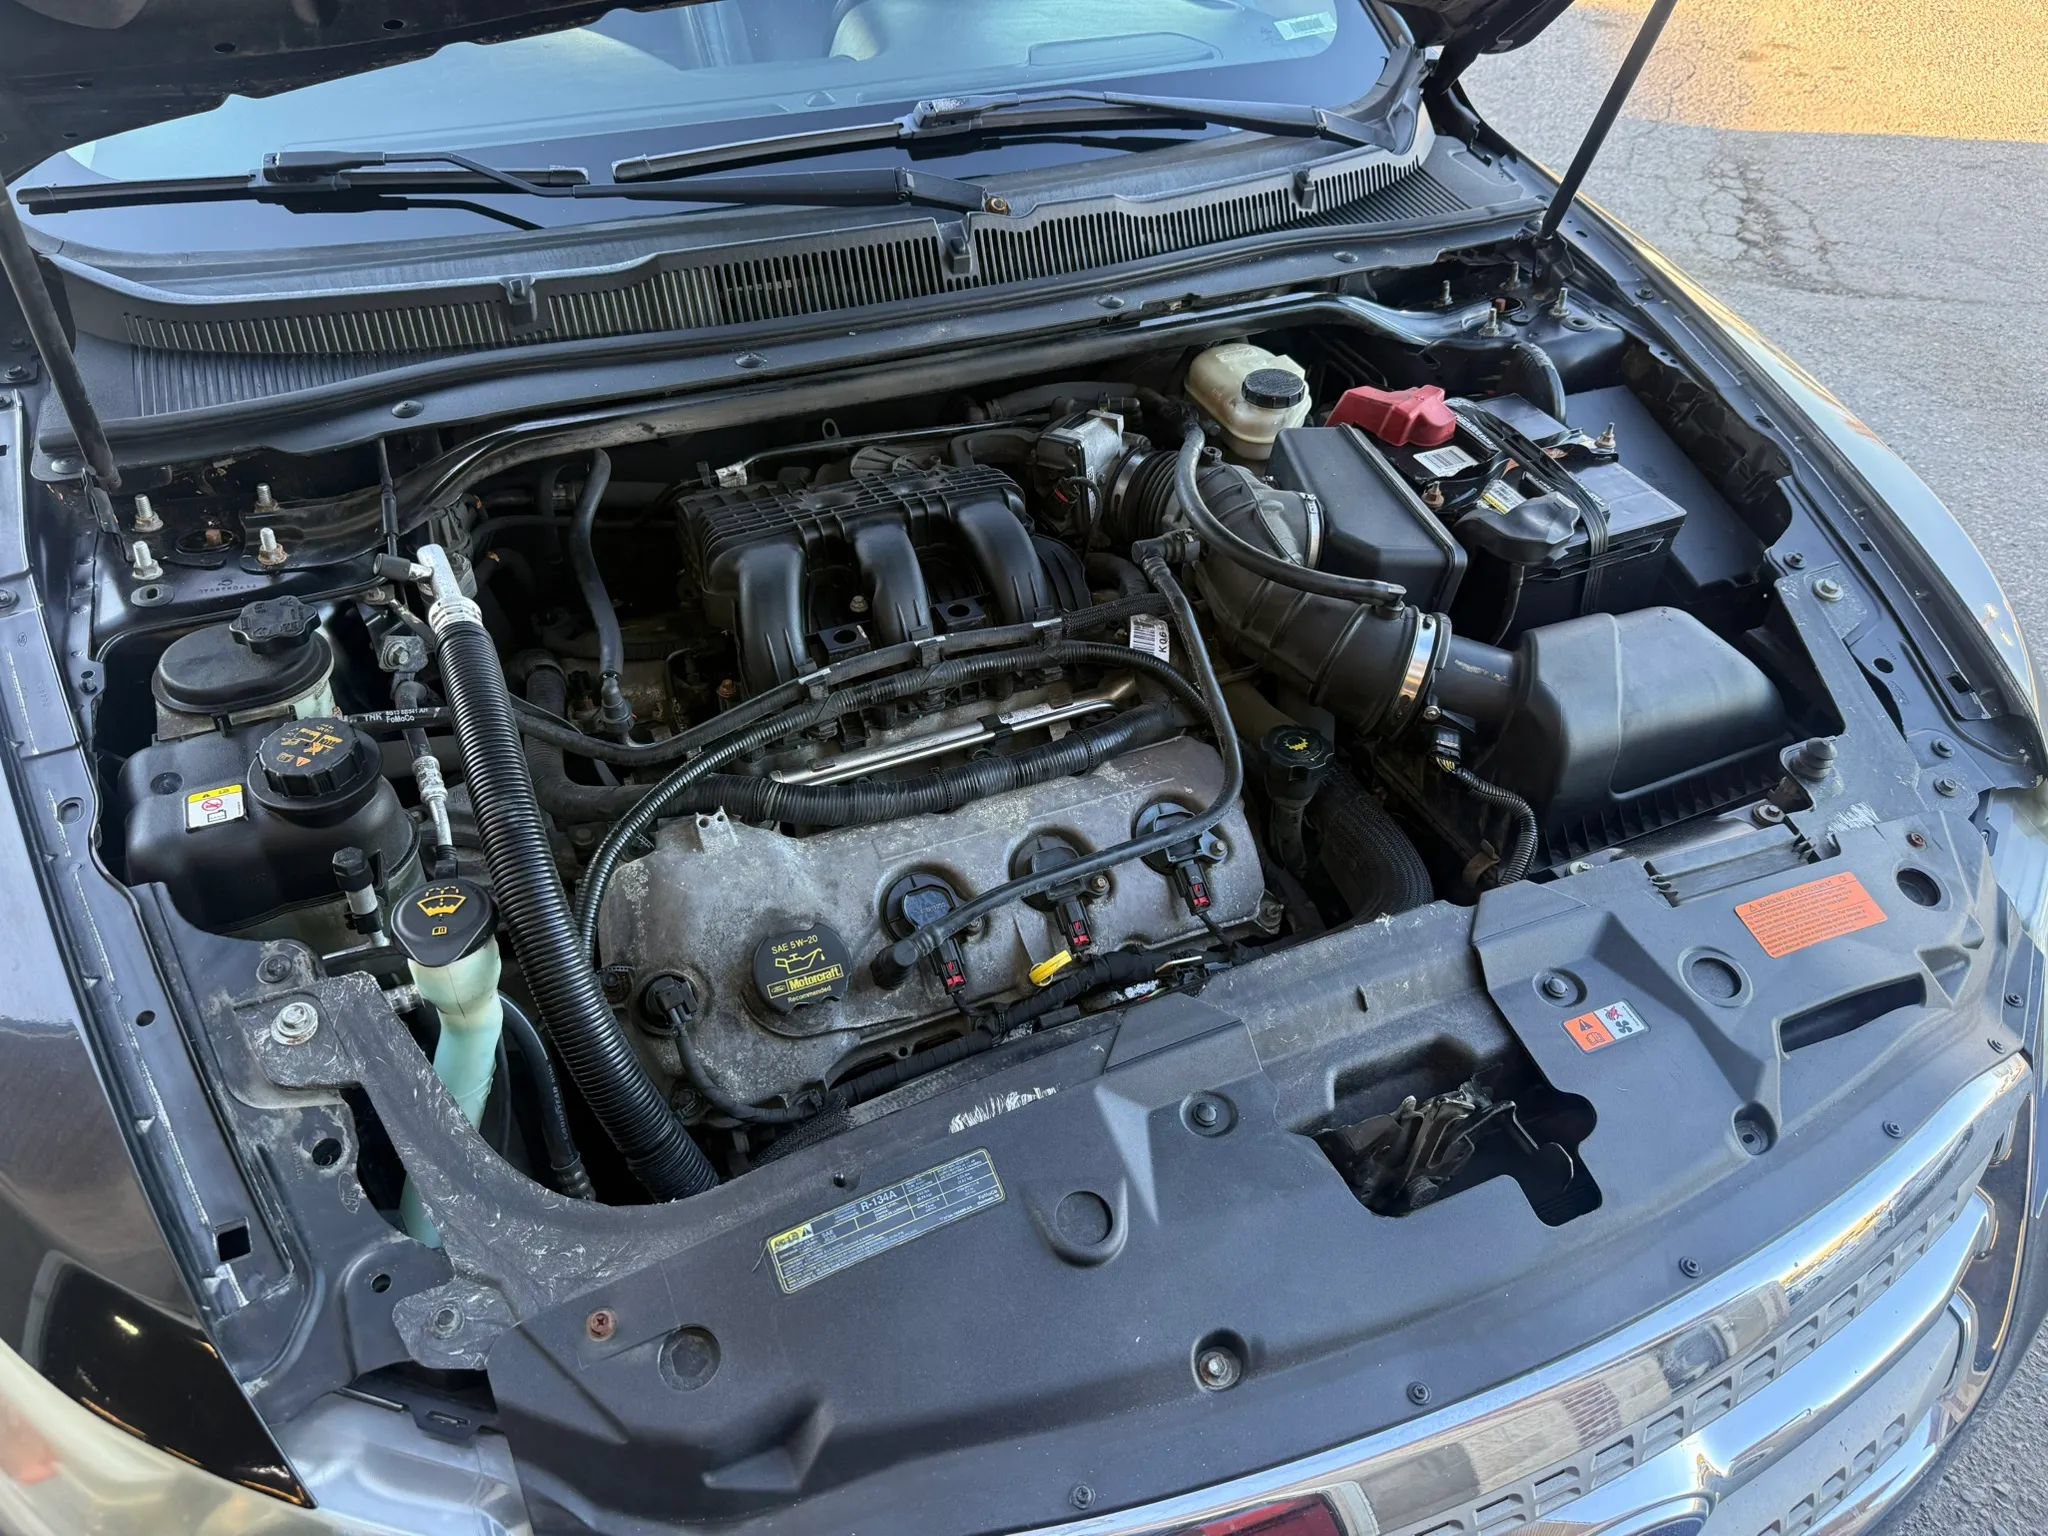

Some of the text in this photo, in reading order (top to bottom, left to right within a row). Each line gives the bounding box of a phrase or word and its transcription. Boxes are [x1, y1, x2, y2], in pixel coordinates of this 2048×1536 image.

[386, 714, 415, 723] FoMoCo
[771, 935, 818, 955] SAE 5W-20
[789, 965, 840, 991] Motorcraft
[787, 984, 832, 1003] Recommended
[860, 1190, 898, 1212] R-134A
